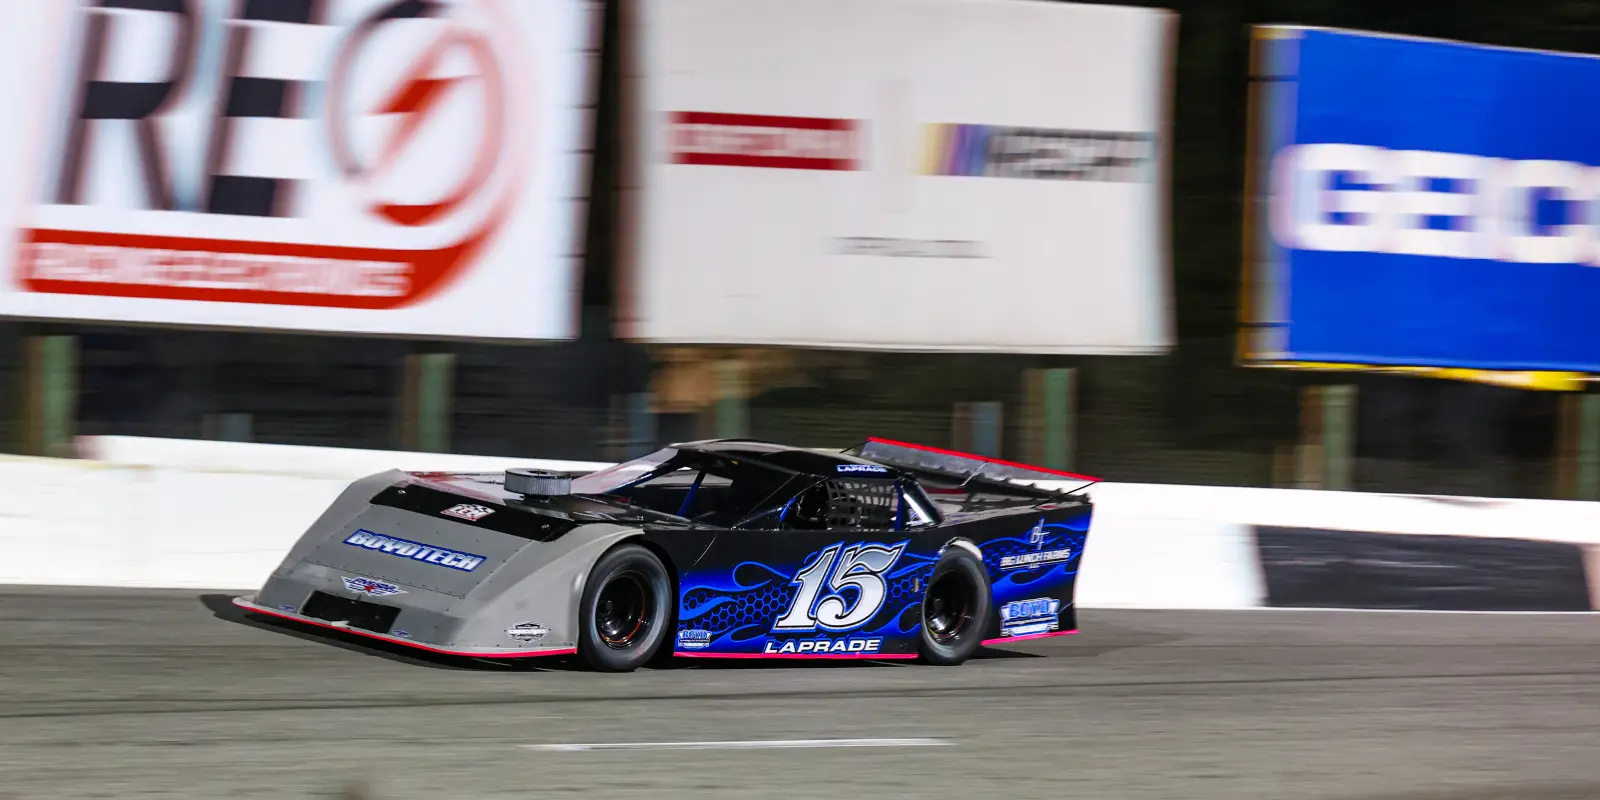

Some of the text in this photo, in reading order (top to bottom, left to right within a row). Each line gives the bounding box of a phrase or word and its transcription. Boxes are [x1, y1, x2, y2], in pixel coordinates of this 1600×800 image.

[344, 529, 485, 571] BOYDTECH
[772, 541, 906, 630] 15
[1009, 599, 1050, 617] BOYD
[682, 630, 708, 639] BOYD
[764, 639, 881, 653] LAPRADE
